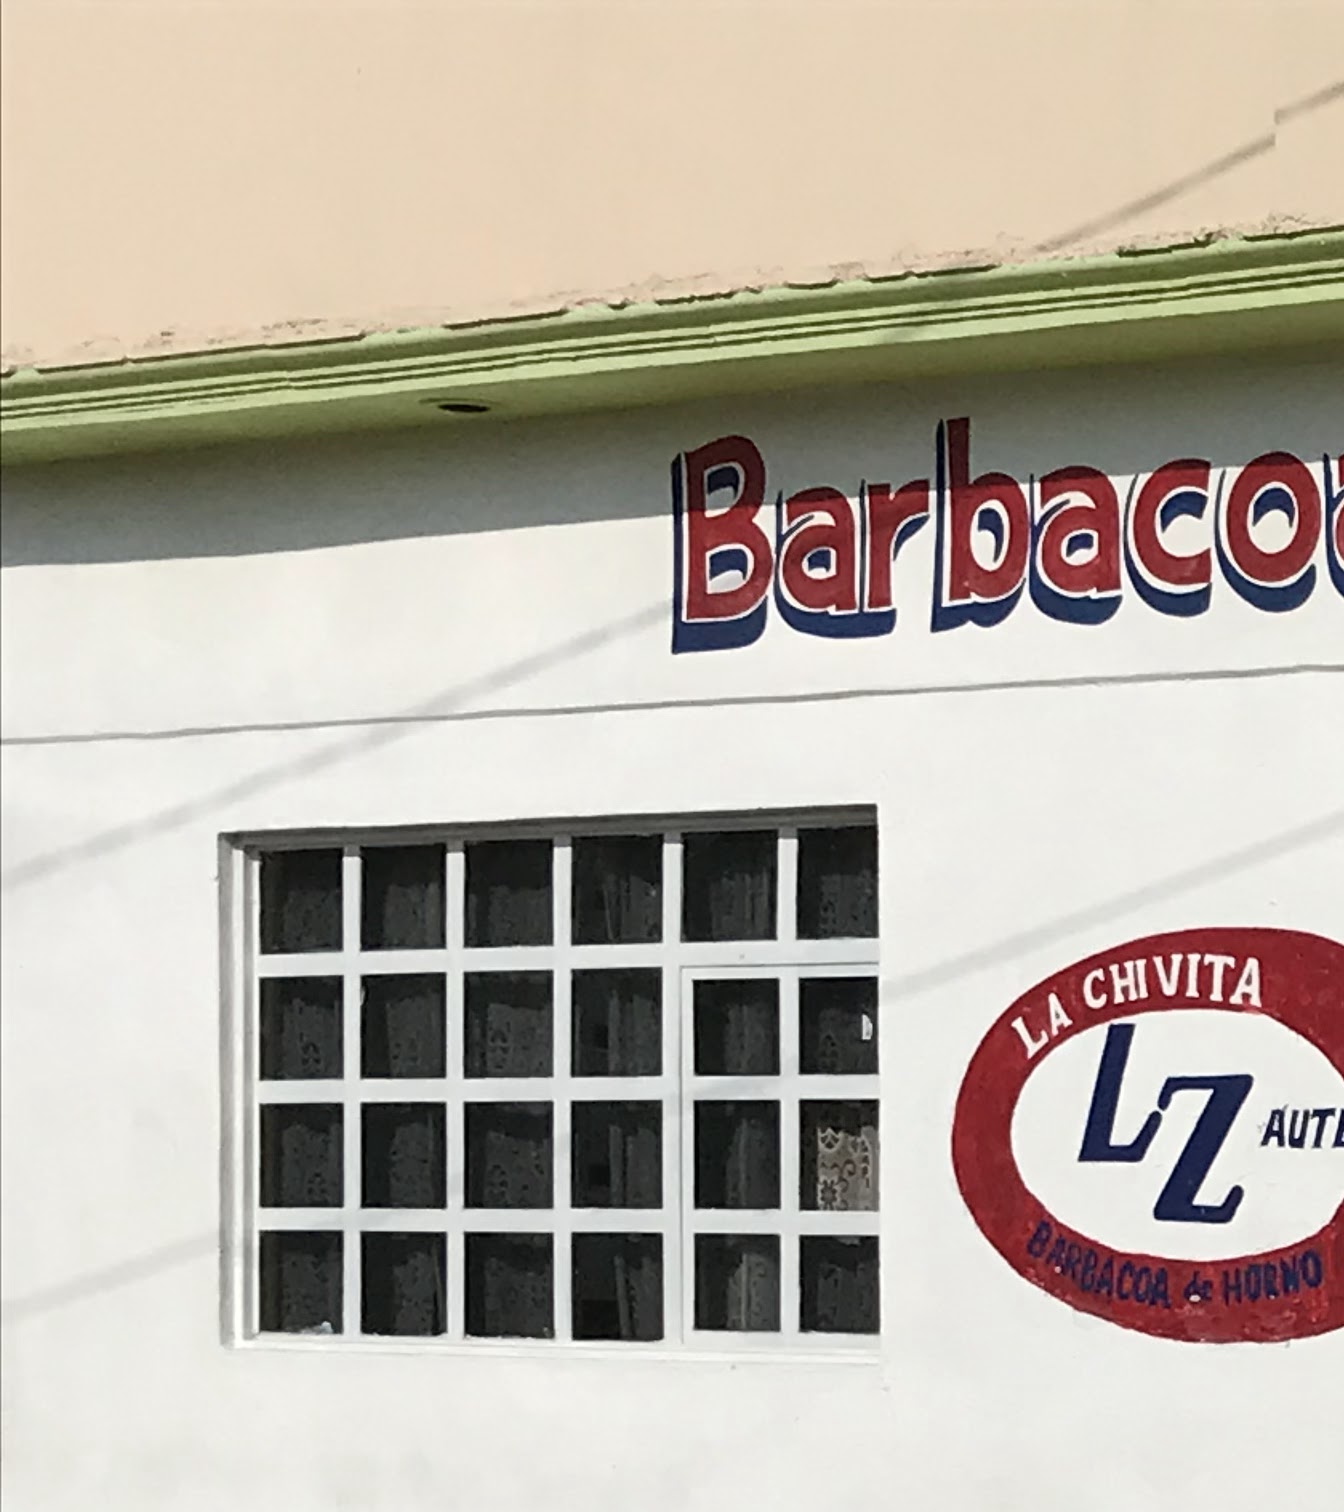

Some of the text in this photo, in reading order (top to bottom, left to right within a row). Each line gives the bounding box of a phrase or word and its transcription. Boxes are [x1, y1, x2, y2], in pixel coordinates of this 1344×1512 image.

[1011, 953, 1264, 1060] LA CHIVITA
[1025, 1220, 1172, 1308] BARBACOA
[1223, 1249, 1324, 1306] HORNO
